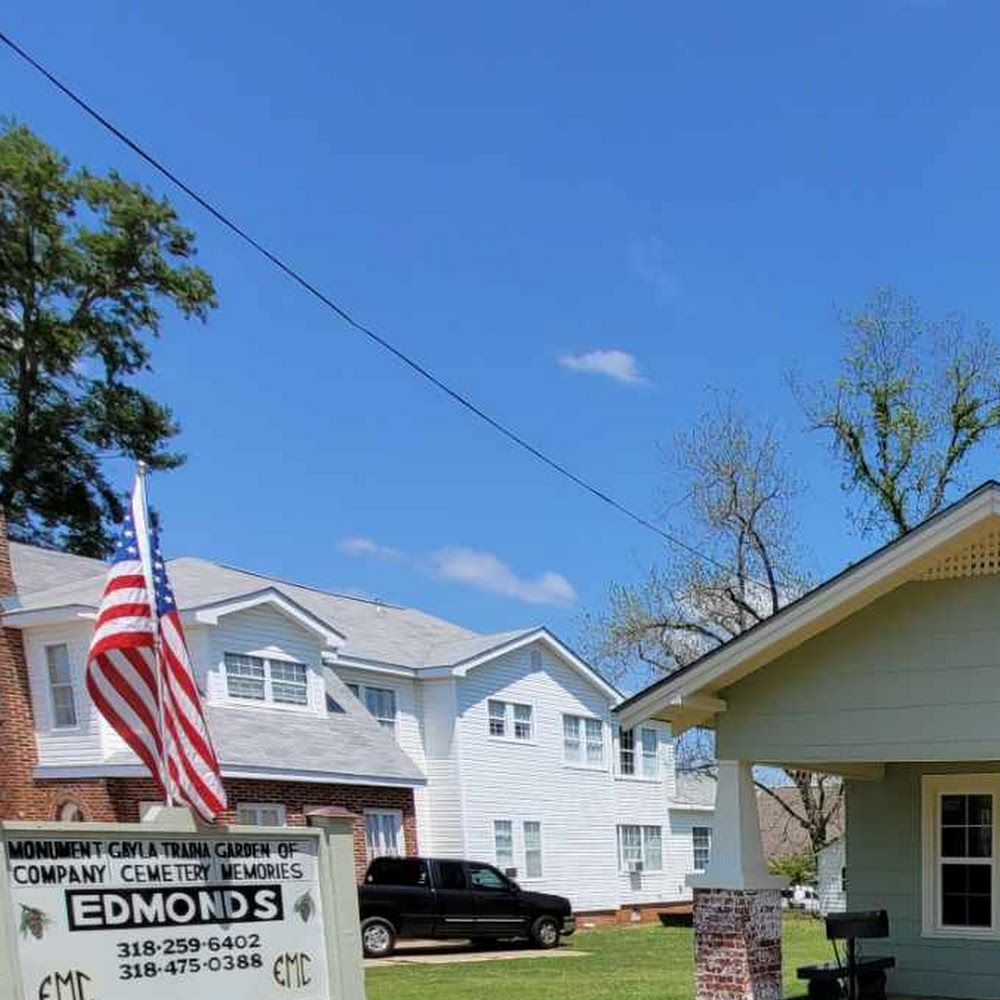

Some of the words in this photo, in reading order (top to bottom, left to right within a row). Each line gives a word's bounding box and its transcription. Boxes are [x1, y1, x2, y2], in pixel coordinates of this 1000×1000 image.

[8, 841, 103, 860] MONUMENT
[107, 841, 158, 859] GAYLA
[215, 842, 271, 859] GARDEN
[278, 842, 299, 859] OF
[13, 865, 106, 884] COMPANY
[120, 864, 211, 882] CEMETERY
[221, 862, 304, 881] MEMORIES
[70, 889, 281, 926] EDMONDS
